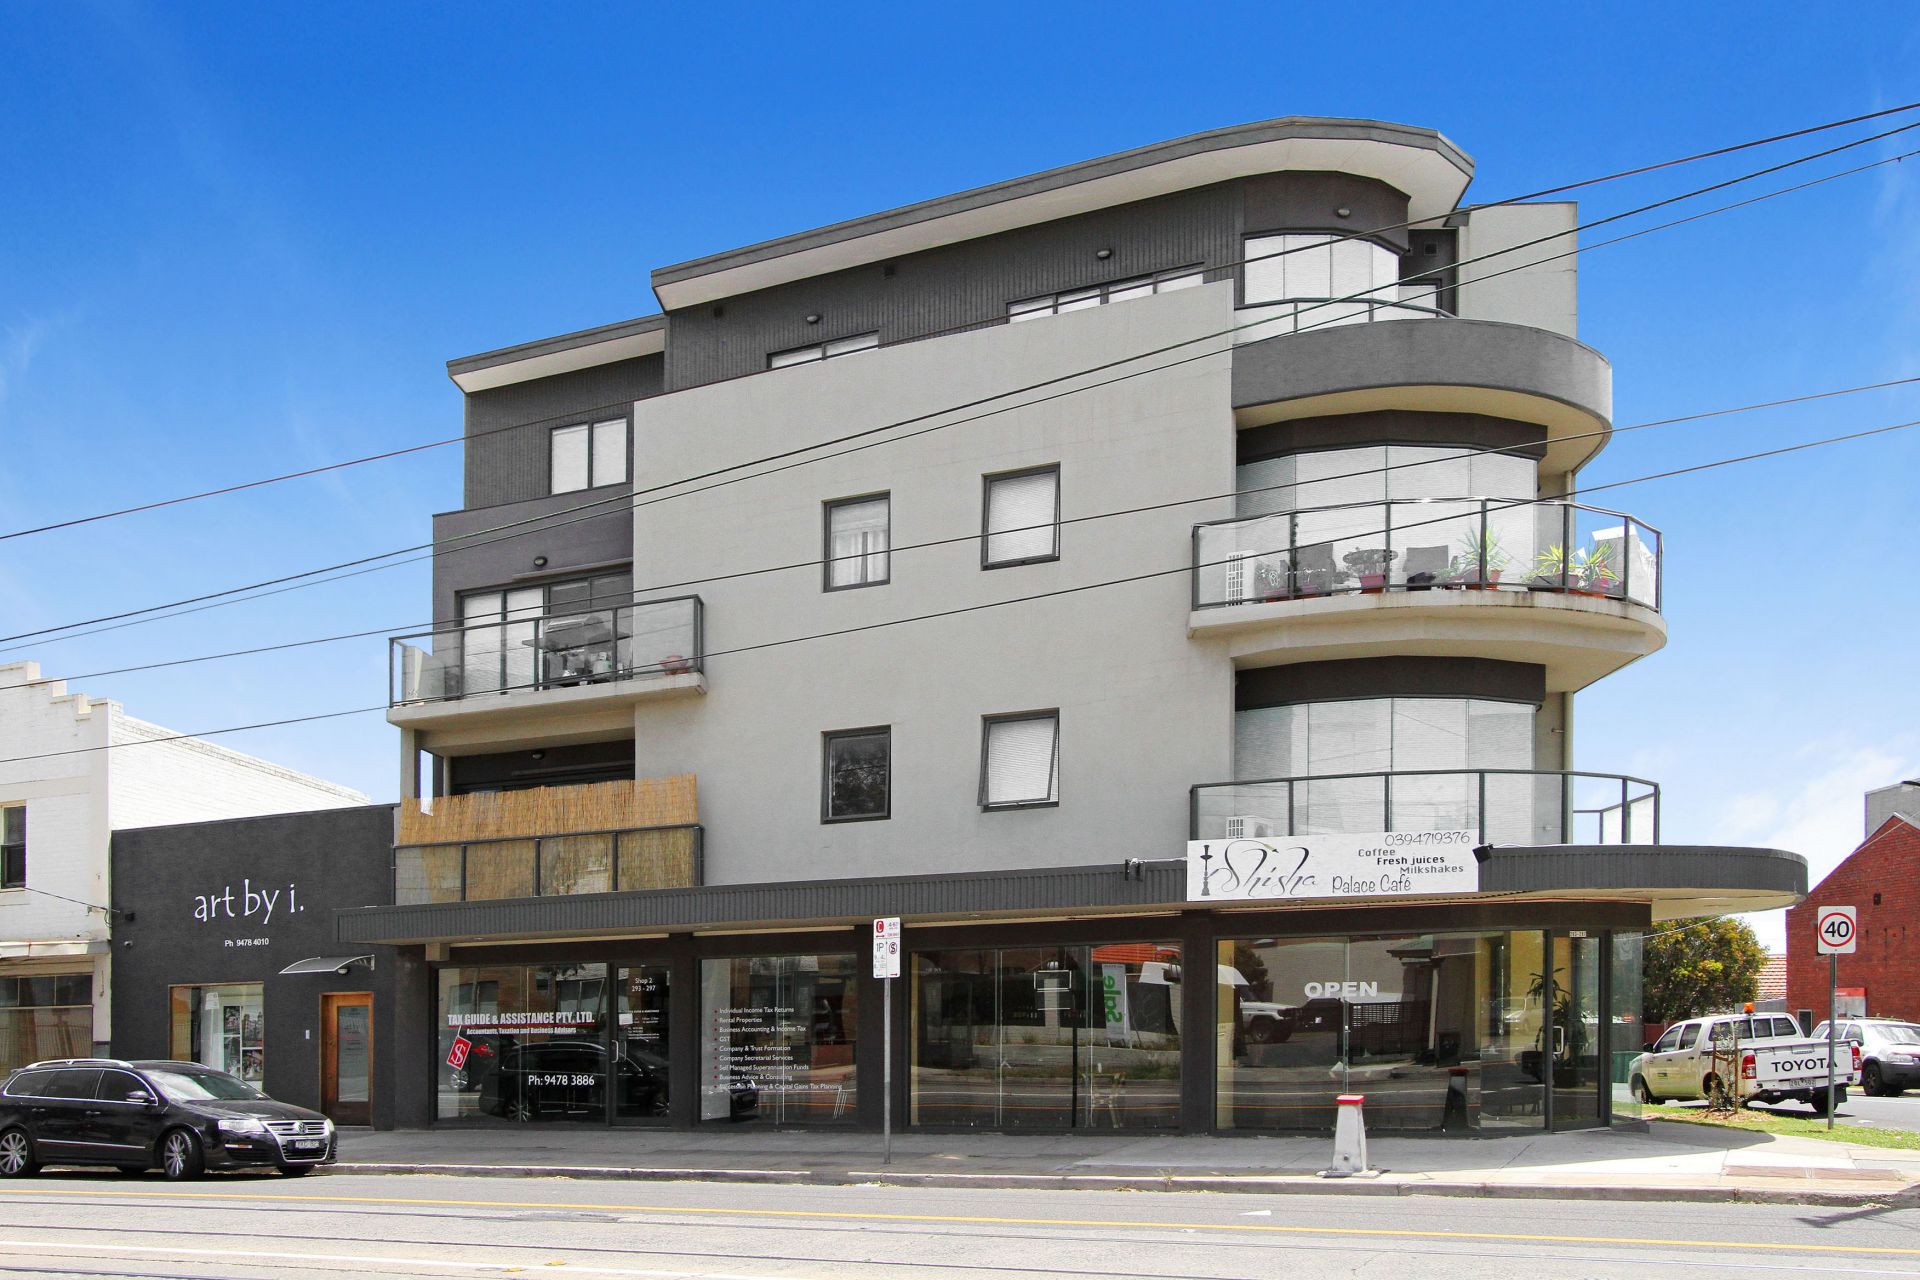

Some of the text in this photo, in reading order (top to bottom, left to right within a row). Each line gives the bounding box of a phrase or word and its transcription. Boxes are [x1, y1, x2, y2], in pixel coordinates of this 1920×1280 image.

[1384, 831, 1470, 846] 0394719376
[1358, 848, 1396, 857] Coffee
[1377, 855, 1445, 866] Fresh juices
[1400, 864, 1464, 874] Milkshakes
[1332, 873, 1412, 894] Palace Café
[194, 886, 235, 922] art
[244, 879, 280, 924] by
[1824, 921, 1850, 938] 40
[236, 939, 252, 947] 9478
[253, 938, 269, 946] 4010
[635, 977, 648, 985] Shop
[1304, 981, 1378, 998] OPEN
[448, 1014, 464, 1026] TAX
[464, 1013, 490, 1025] GUIDE
[491, 1015, 499, 1025] &
[500, 1012, 554, 1025] ASSISTANCE
[576, 1011, 595, 1023] LTD.
[735, 1016, 763, 1024] Properties
[741, 1026, 770, 1034] Accounting
[719, 1045, 743, 1053] Company
[729, 1064, 753, 1072] Managed
[528, 1074, 595, 1086] Ph: 9478 3886
[746, 1083, 769, 1091] Plnning
